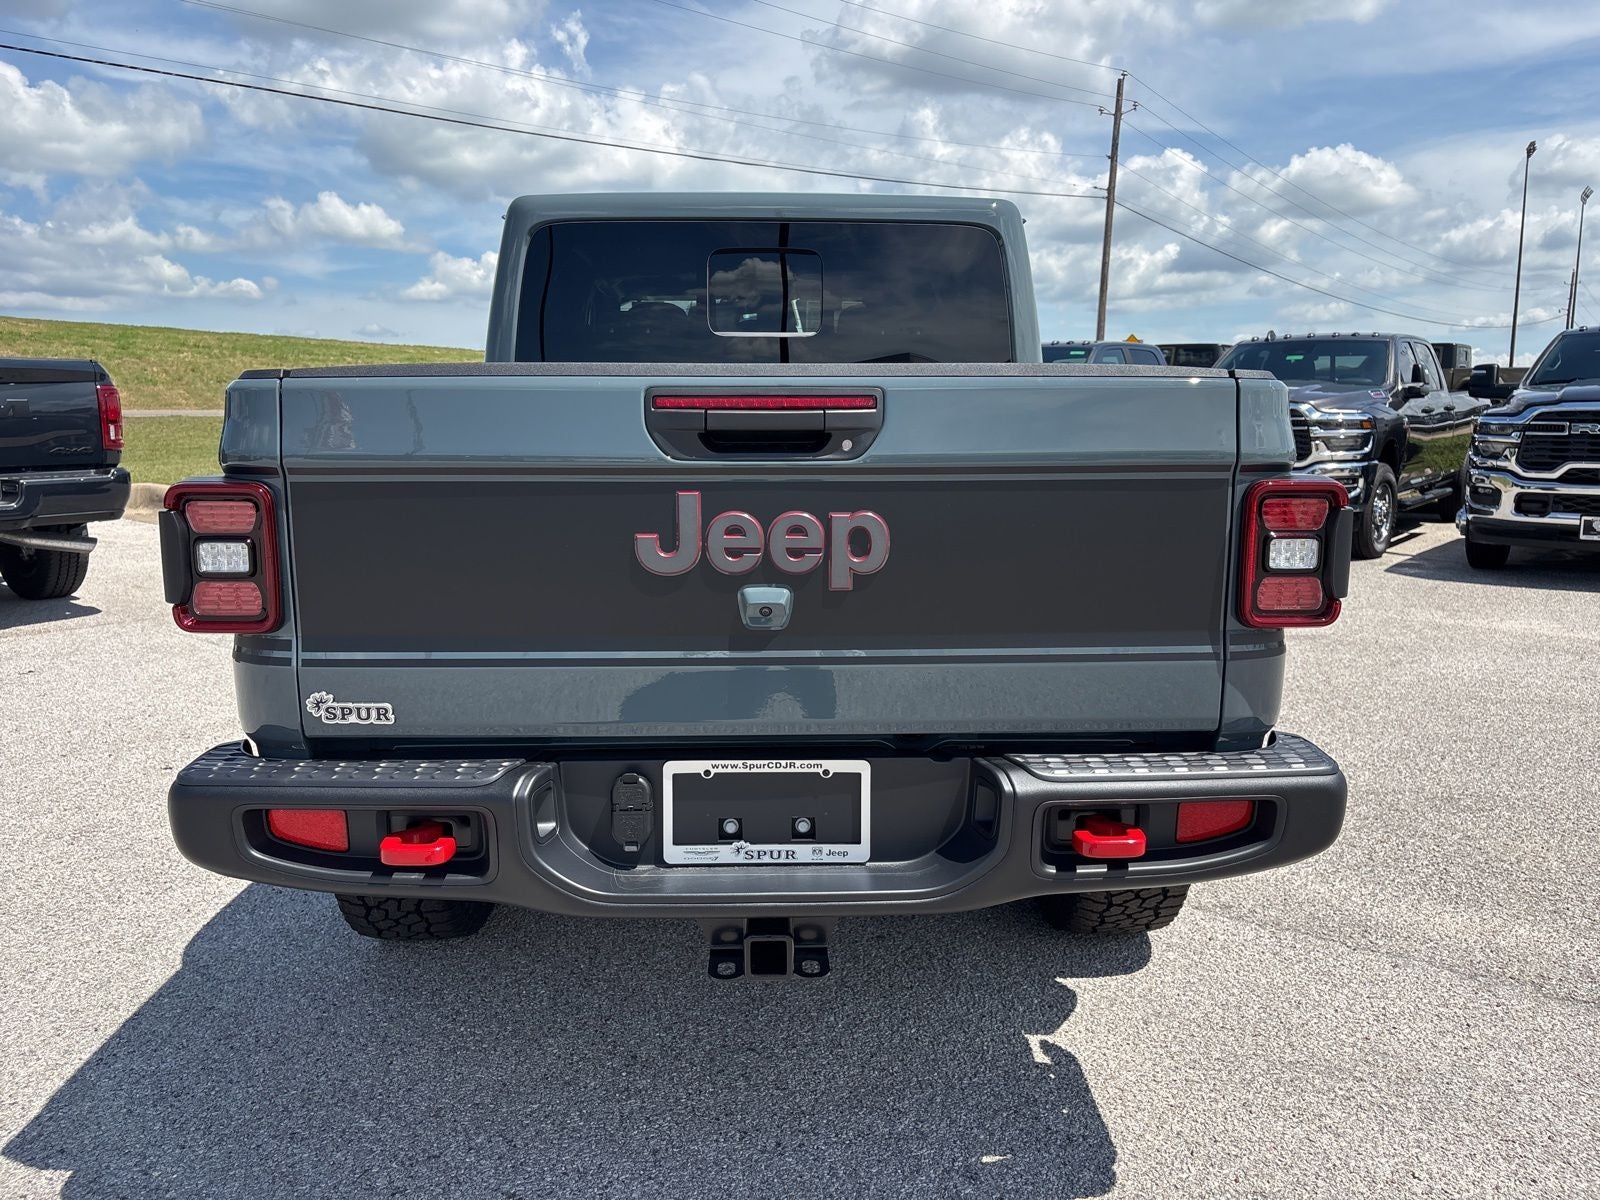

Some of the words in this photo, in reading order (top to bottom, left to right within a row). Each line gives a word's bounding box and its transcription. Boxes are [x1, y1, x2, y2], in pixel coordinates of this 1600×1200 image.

[634, 489, 891, 591] Jeep
[324, 706, 391, 721] SPUR
[711, 761, 823, 771] www.SpurCDJR.com
[744, 849, 797, 861] SPUR
[825, 848, 849, 858] Jeep
